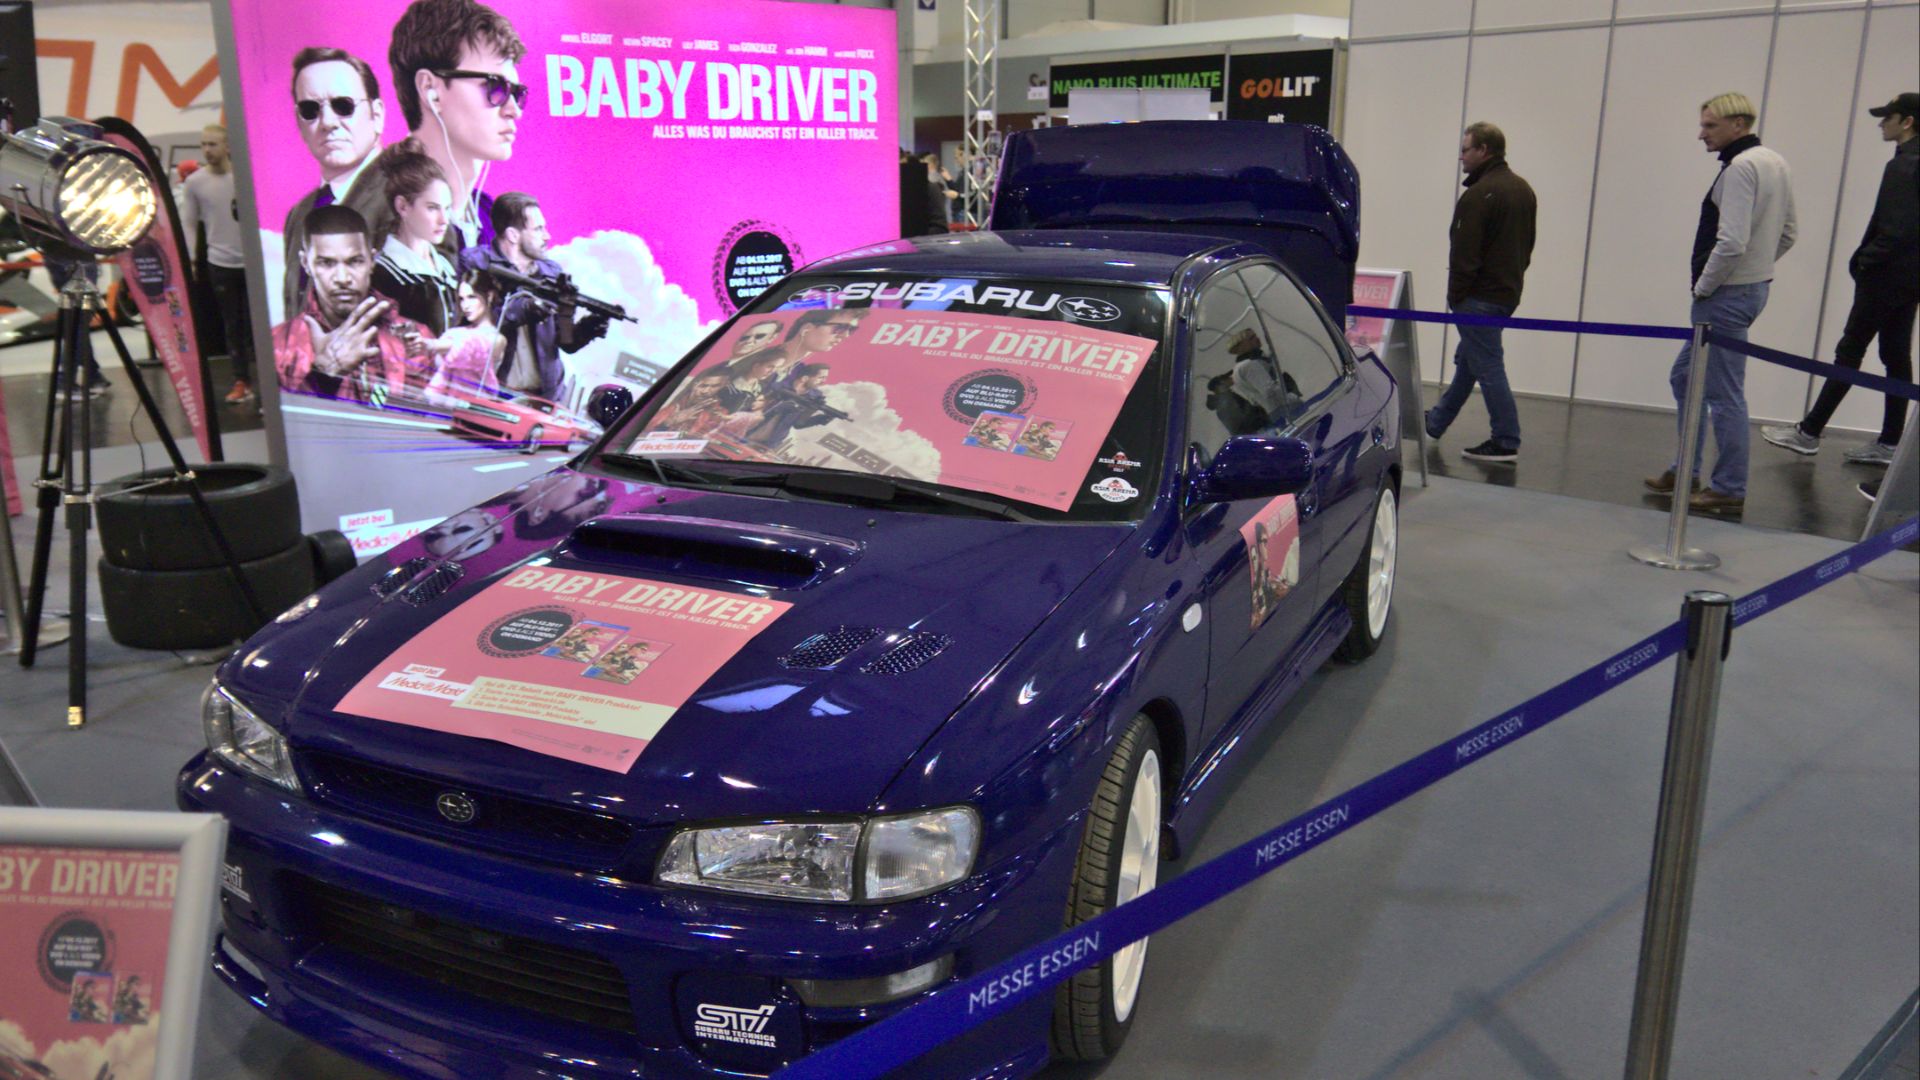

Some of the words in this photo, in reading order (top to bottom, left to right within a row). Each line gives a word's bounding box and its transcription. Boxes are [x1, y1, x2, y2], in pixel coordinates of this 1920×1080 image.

[545, 54, 696, 120] BABY
[705, 61, 879, 123] DRIVER
[1142, 71, 1221, 88] ULTIMATE
[652, 124, 684, 139] ALLES
[686, 125, 710, 139] WAS
[712, 126, 727, 139] DU
[729, 126, 780, 140] BRAUCHST
[782, 126, 797, 140] IST
[799, 127, 815, 140] EIN
[816, 127, 846, 140] KILLER
[1267, 113, 1285, 123] mit
[838, 281, 1061, 312] SUBARU
[871, 323, 982, 351] BABY
[988, 331, 1140, 375] DRIVER
[503, 569, 625, 599] BABY
[616, 579, 774, 626] DRIVER
[1604, 660, 1633, 680] MESSE
[1632, 640, 1660, 667] ESSEN
[1455, 730, 1490, 762] MESSE
[1490, 713, 1525, 744] ESSEN
[1255, 825, 1302, 867] MESSE
[1304, 803, 1350, 842] ESSEN
[50, 858, 180, 898] DRIVER
[968, 961, 1035, 1015] MESSE
[1039, 930, 1102, 980] ESSEN
[694, 1024, 731, 1036] SUBARU
[731, 1030, 777, 1042] TECHNICA
[695, 1031, 777, 1048] INTERNATIONAL
